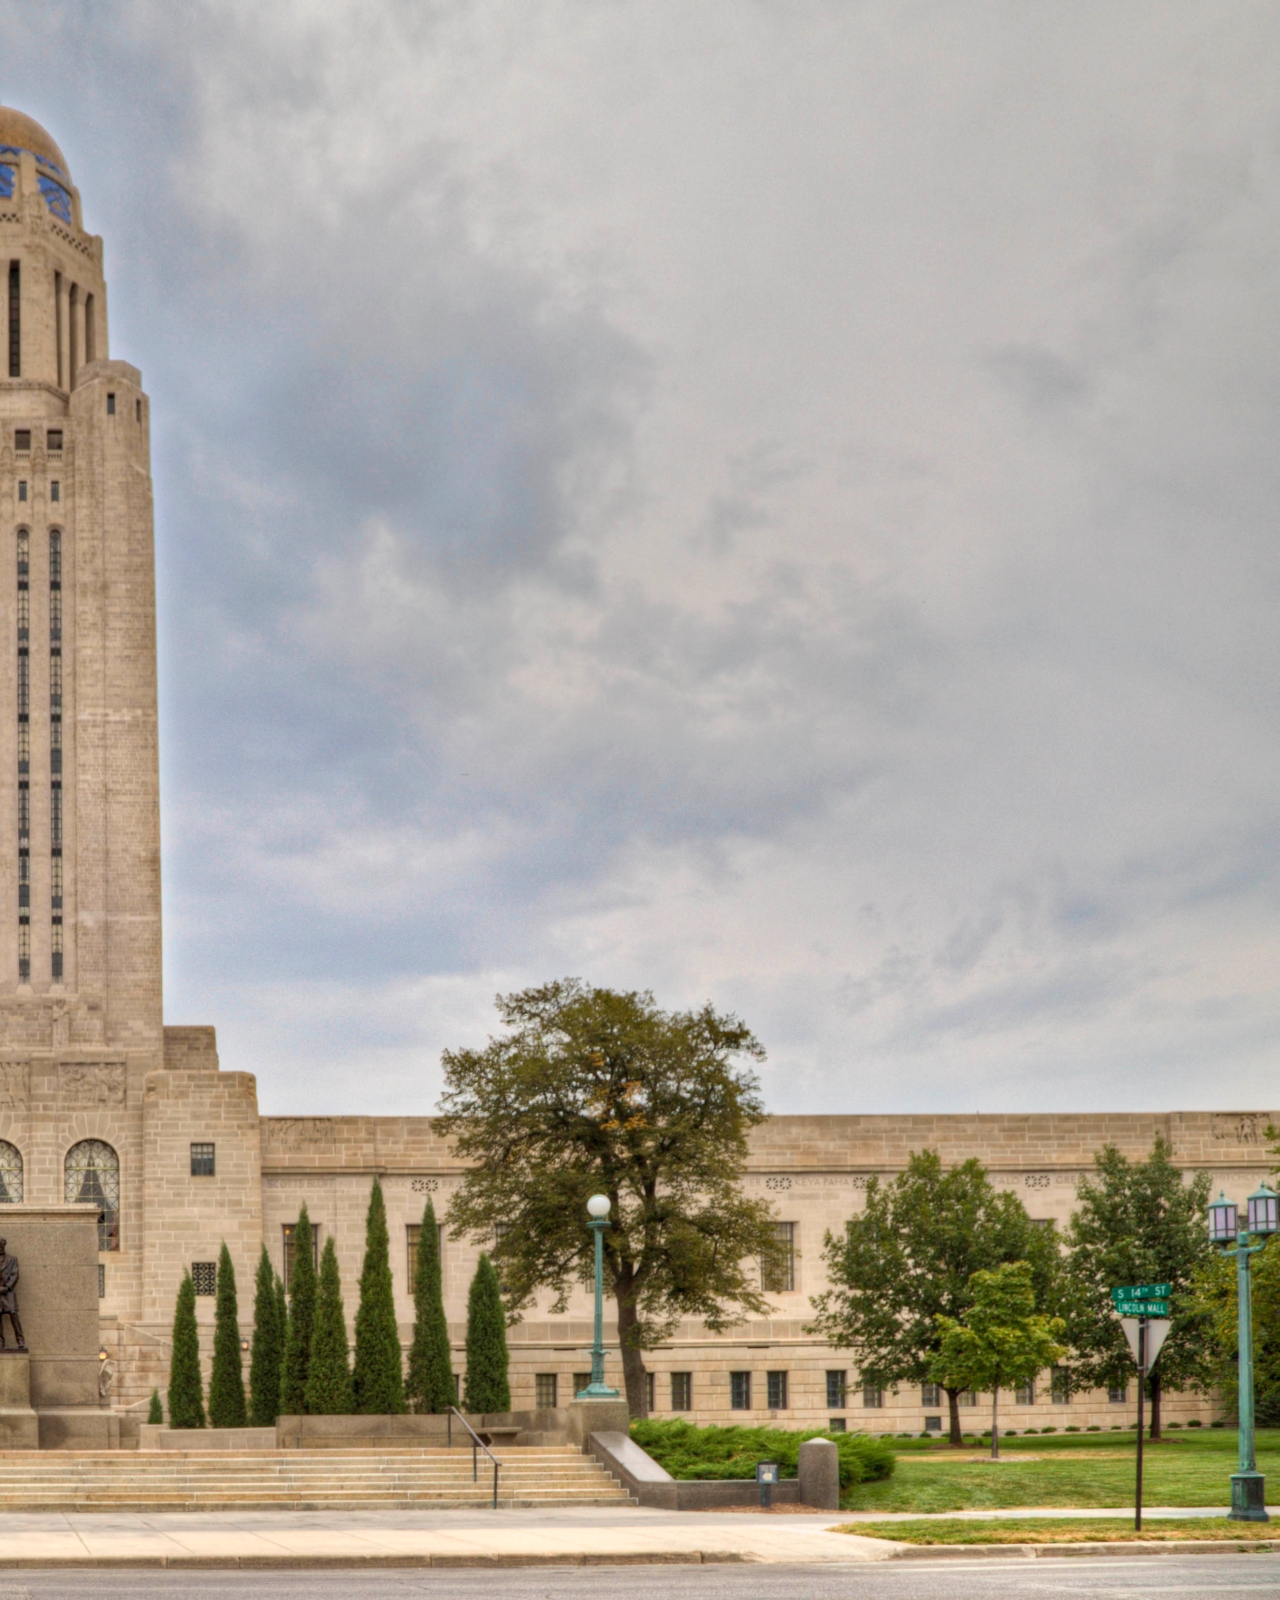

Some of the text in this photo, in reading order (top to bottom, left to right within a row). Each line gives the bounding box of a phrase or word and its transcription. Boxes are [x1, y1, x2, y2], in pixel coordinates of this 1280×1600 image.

[267, 1179, 334, 1188] SCOTTS BLUFF
[795, 1177, 850, 1187] KEYA PAHA
[1117, 1285, 1167, 1299] S 14TH ST
[1118, 1303, 1165, 1314] LINCOLN MALL
